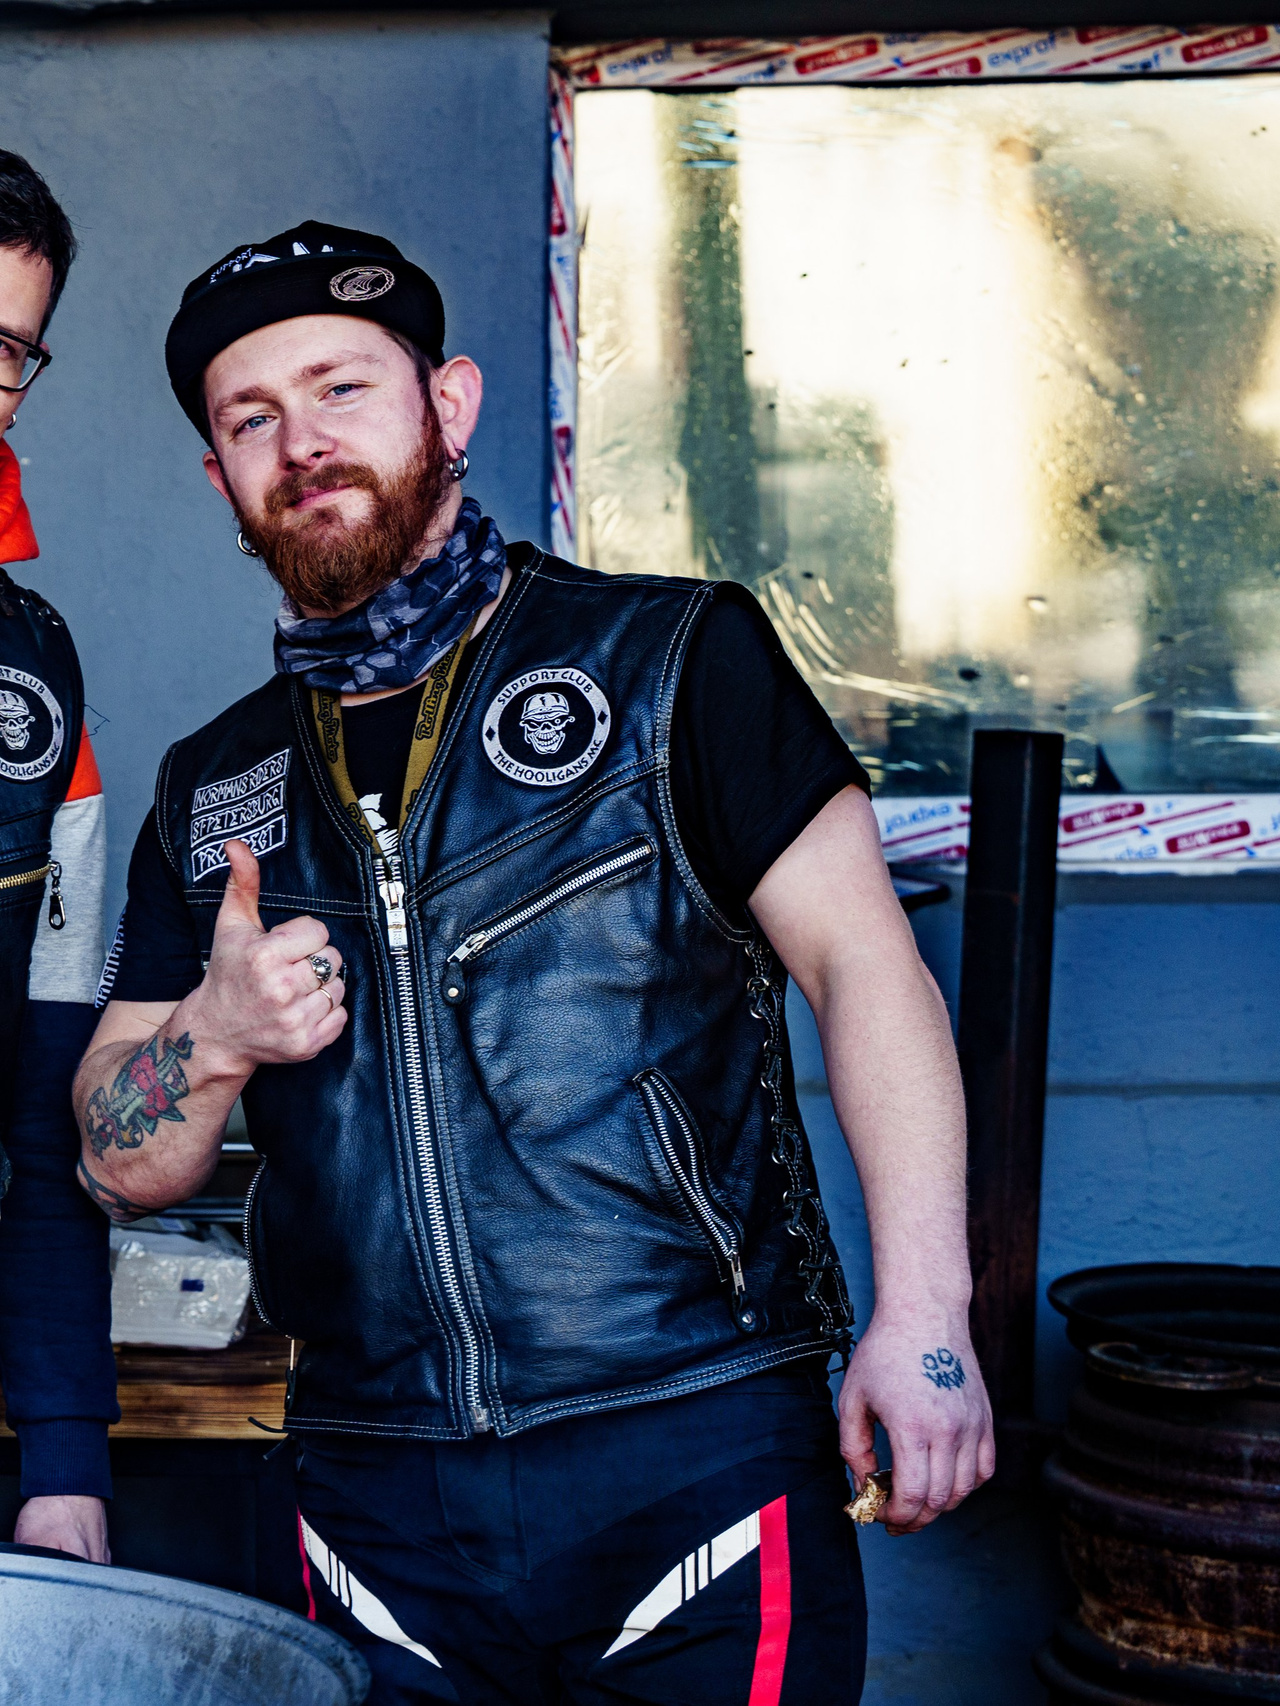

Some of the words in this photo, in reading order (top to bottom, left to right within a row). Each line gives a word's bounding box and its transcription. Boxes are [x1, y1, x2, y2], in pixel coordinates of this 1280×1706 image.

[14, 672, 46, 694] CLUB
[497, 670, 558, 705] SUPPORT
[561, 670, 593, 694] CLUB
[415, 679, 448, 740] Rolling
[50, 743, 61, 762] MC
[493, 750, 515, 773] THE
[515, 757, 589, 783] HOOLIGANS
[588, 739, 602, 761] MC
[195, 776, 249, 809] NORMANS
[249, 755, 284, 791] RIDERS
